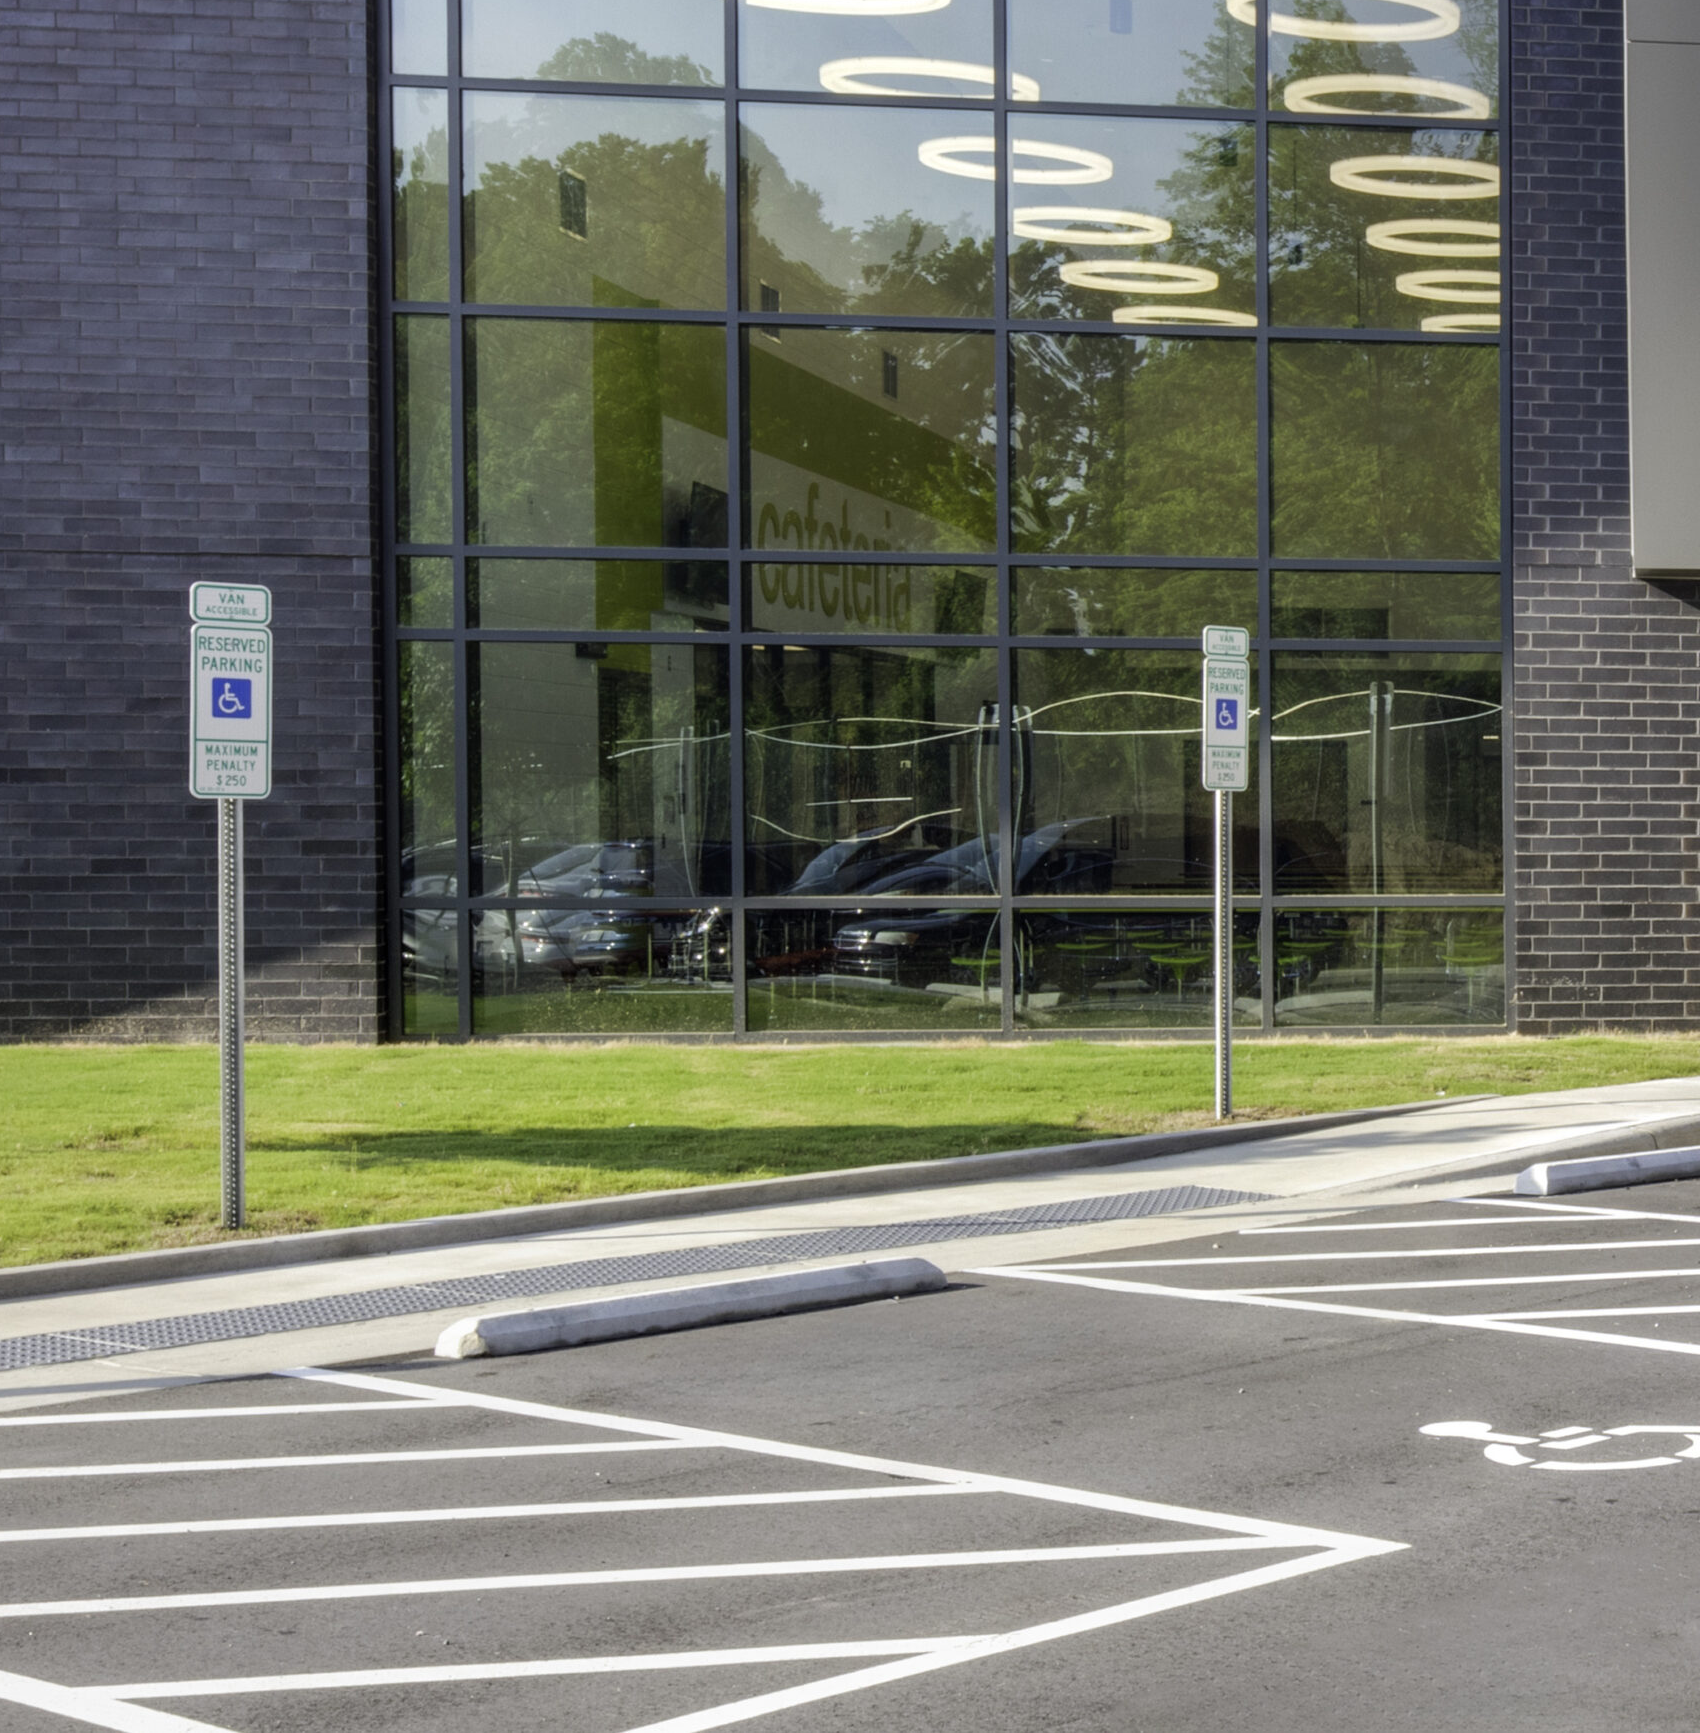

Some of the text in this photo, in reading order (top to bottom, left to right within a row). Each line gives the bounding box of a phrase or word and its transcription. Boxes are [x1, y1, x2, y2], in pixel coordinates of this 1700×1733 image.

[758, 482, 911, 633] cafeteria
[219, 593, 245, 605] VAN
[205, 605, 258, 617] ACCESSIBLE
[1219, 634, 1235, 643] VAN
[198, 636, 266, 654] RESERVED
[202, 656, 263, 673] PARKING
[1208, 666, 1246, 680] RESERVED
[1210, 682, 1245, 695] PARKING
[205, 744, 258, 756] MAXIMUM
[1212, 749, 1241, 758] MAXIMUM
[206, 759, 256, 771] PENALTY
[1212, 760, 1240, 770] PENALTY
